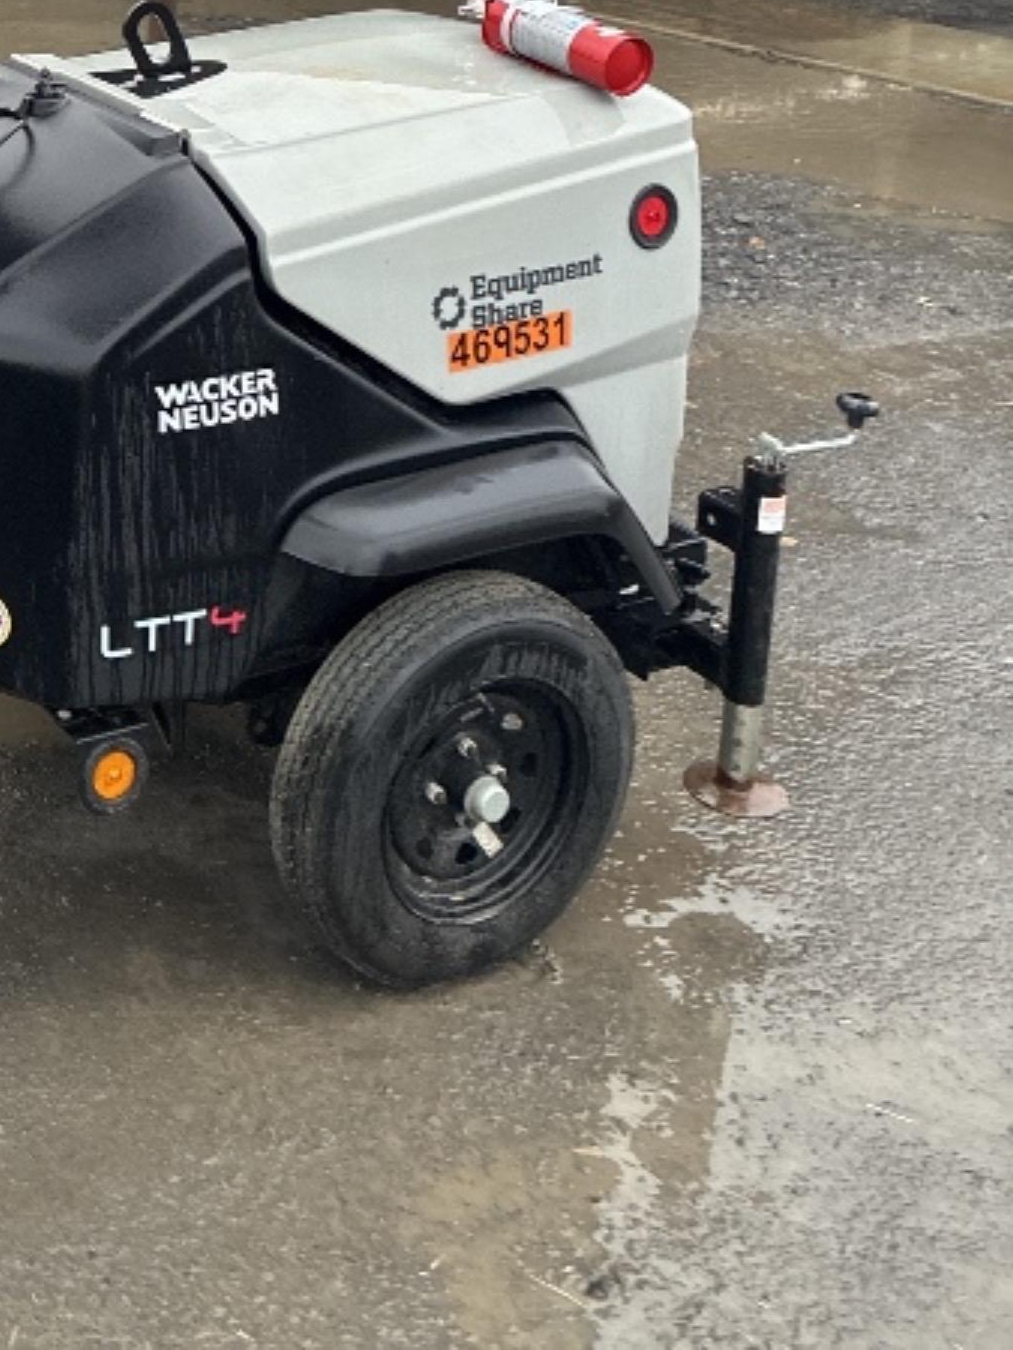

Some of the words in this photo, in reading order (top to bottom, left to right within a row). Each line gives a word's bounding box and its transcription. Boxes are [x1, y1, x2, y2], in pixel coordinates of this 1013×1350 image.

[470, 253, 602, 300] Equipment
[471, 299, 543, 328] Share
[450, 311, 569, 366] 469531
[154, 368, 278, 409] WACKER
[157, 393, 279, 433] NEUSON
[100, 607, 247, 658] LTT4
